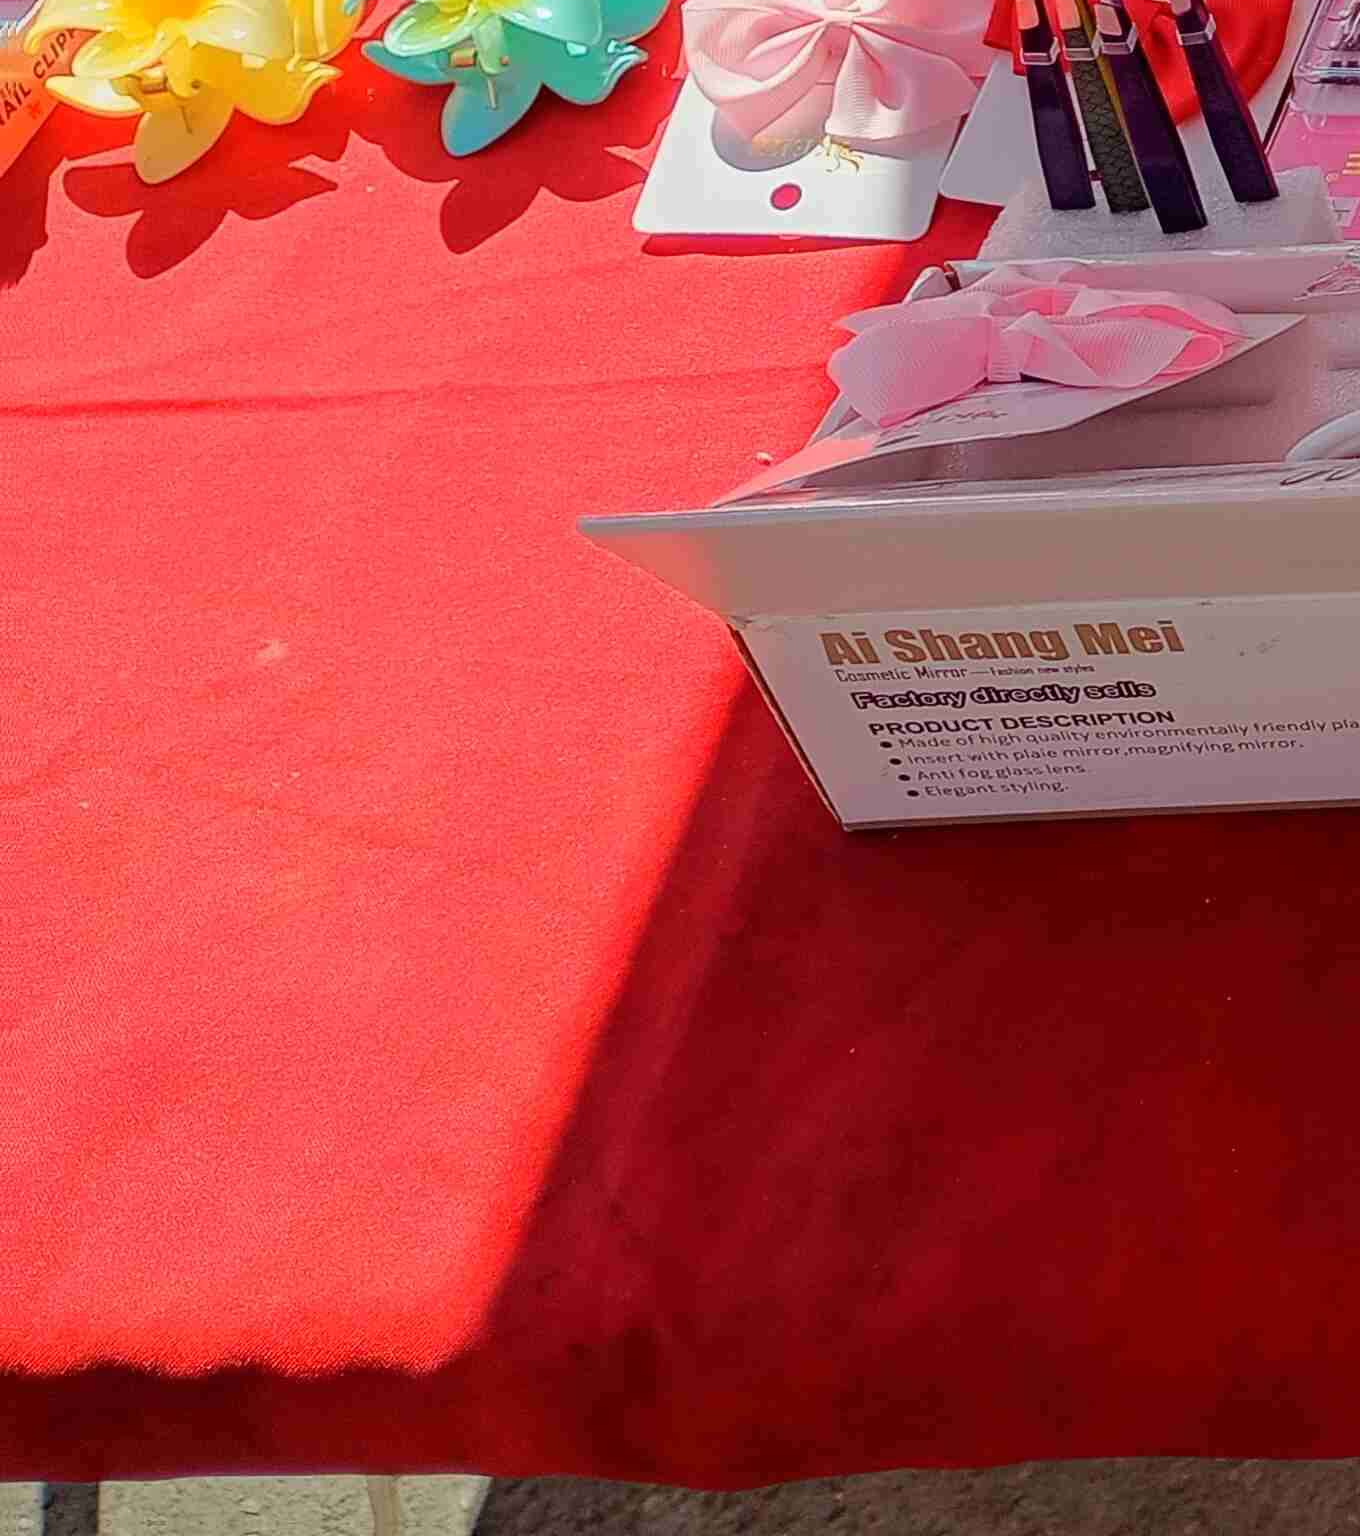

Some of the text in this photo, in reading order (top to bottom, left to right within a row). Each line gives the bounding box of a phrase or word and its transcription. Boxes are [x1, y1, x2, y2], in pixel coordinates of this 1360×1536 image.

[820, 619, 1185, 665] Ai Shang Mei
[835, 667, 912, 683] Cosmetic
[917, 666, 968, 680] Mirror
[850, 680, 1157, 709] Factory directly sells
[869, 710, 1176, 735] PRODUCT DESCRIPTION
[900, 737, 951, 750] Made
[954, 735, 976, 747] of
[978, 733, 1021, 748] high
[1025, 729, 1089, 745] quality
[1094, 724, 1249, 742] environmentally
[1253, 720, 1326, 734] friendly
[966, 749, 1010, 763] with
[918, 768, 955, 782] Anti
[960, 767, 994, 781] fog
[995, 764, 1044, 779] glass
[924, 779, 1069, 799] Elegant styling.
